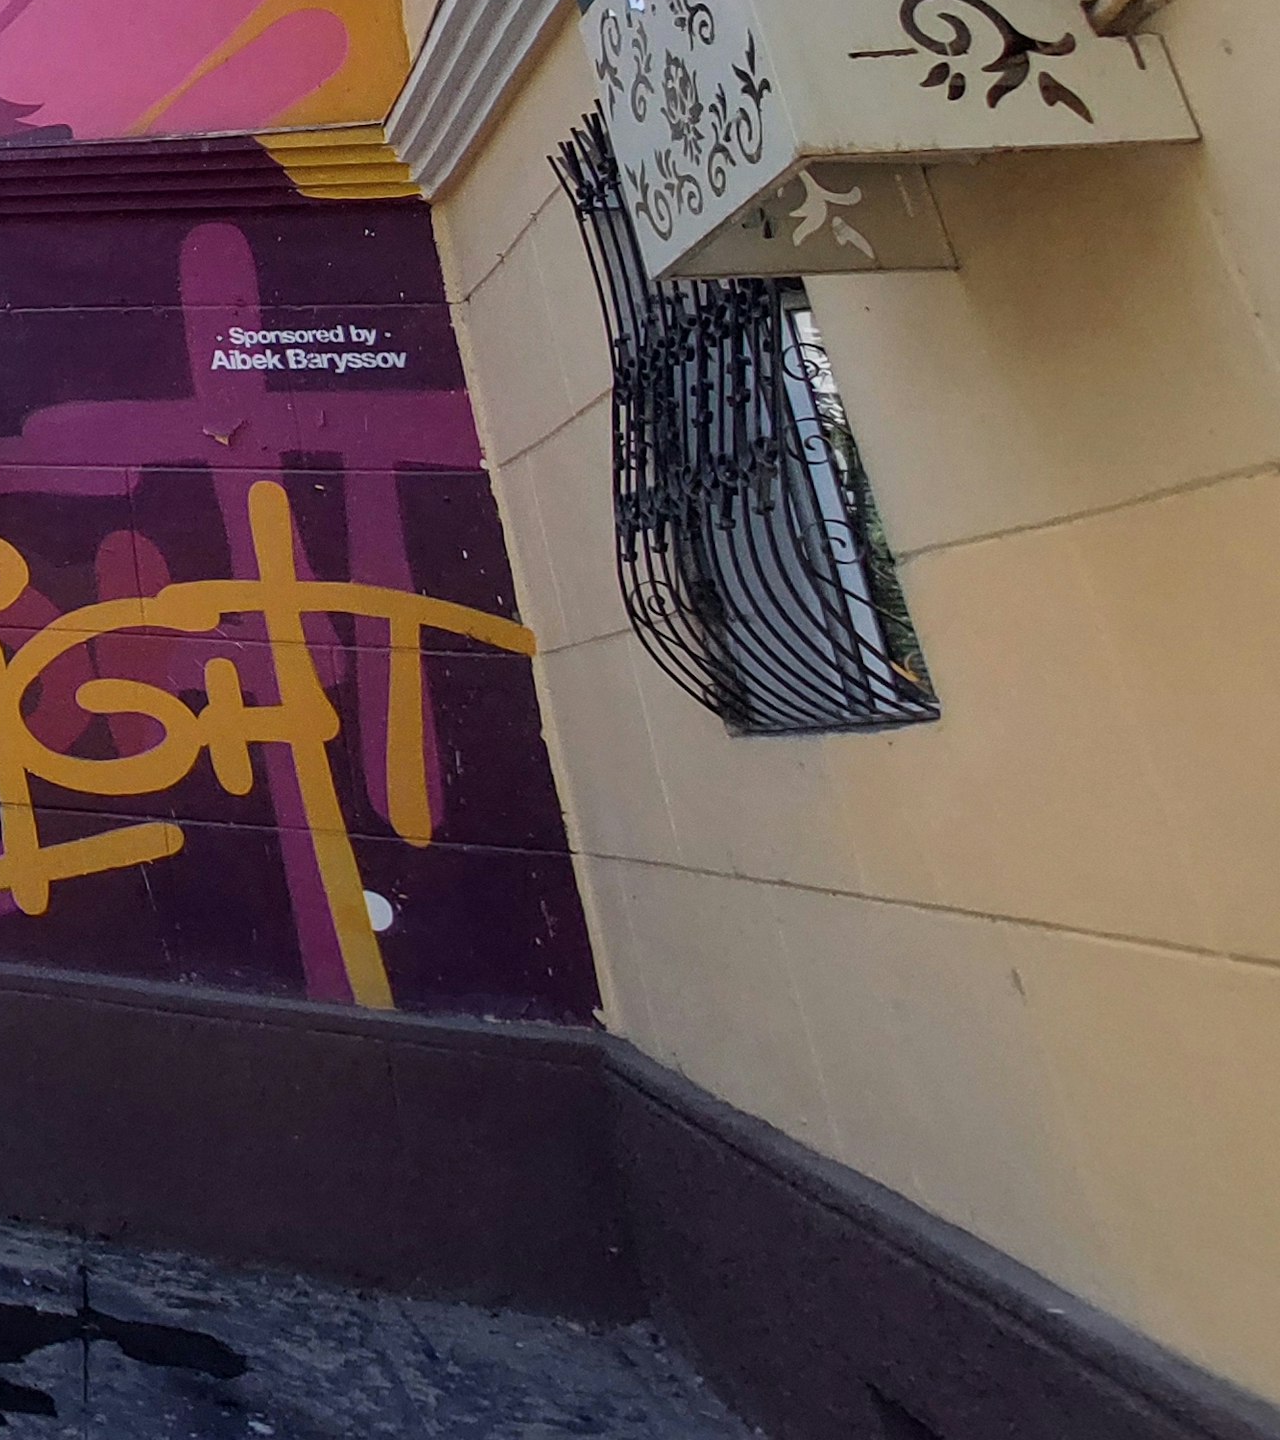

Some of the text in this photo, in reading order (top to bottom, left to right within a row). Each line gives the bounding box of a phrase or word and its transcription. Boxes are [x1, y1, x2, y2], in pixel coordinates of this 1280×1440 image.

[228, 324, 377, 348] Sponsored by
[210, 348, 408, 375] Aibek Baryssov
